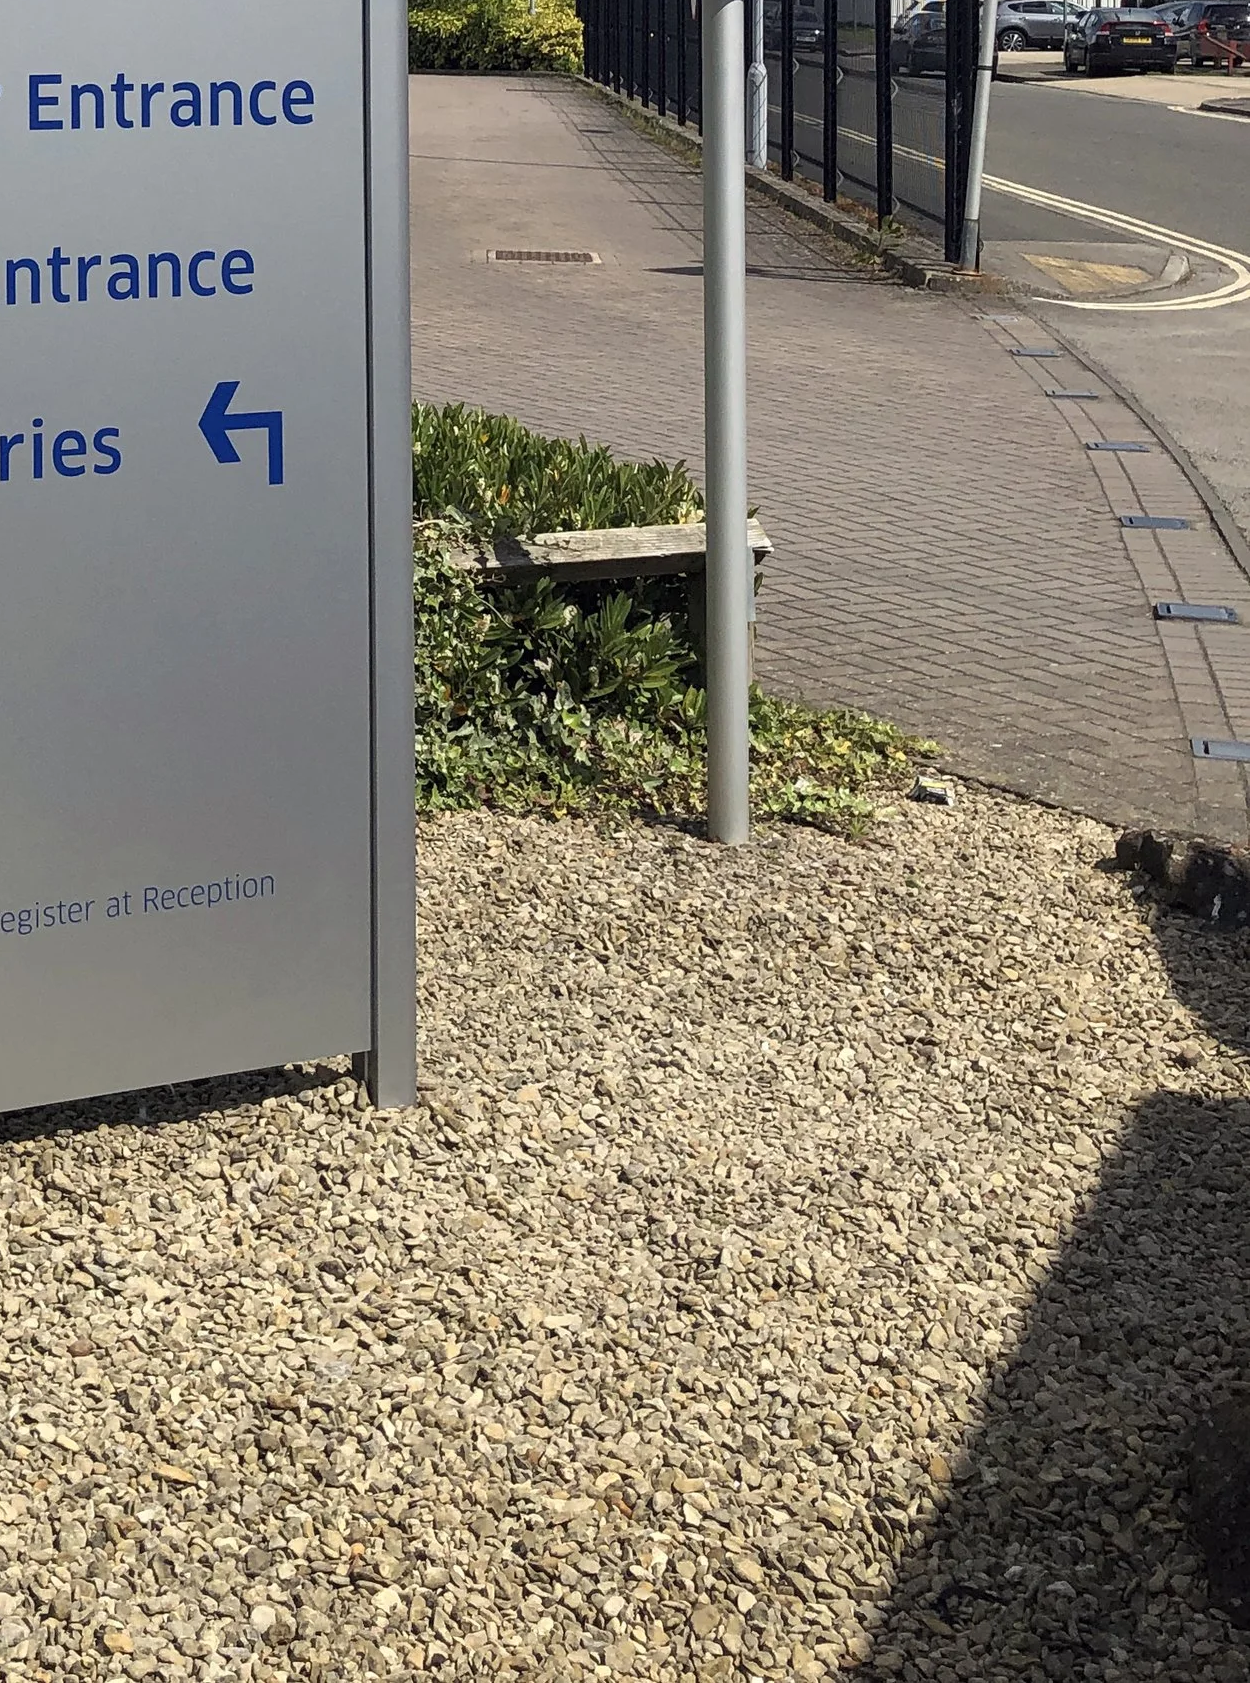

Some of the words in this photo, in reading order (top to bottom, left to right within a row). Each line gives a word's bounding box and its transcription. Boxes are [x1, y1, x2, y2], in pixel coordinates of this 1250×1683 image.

[28, 73, 315, 131] Entrance
[106, 890, 132, 918] at
[143, 872, 276, 914] Reception
